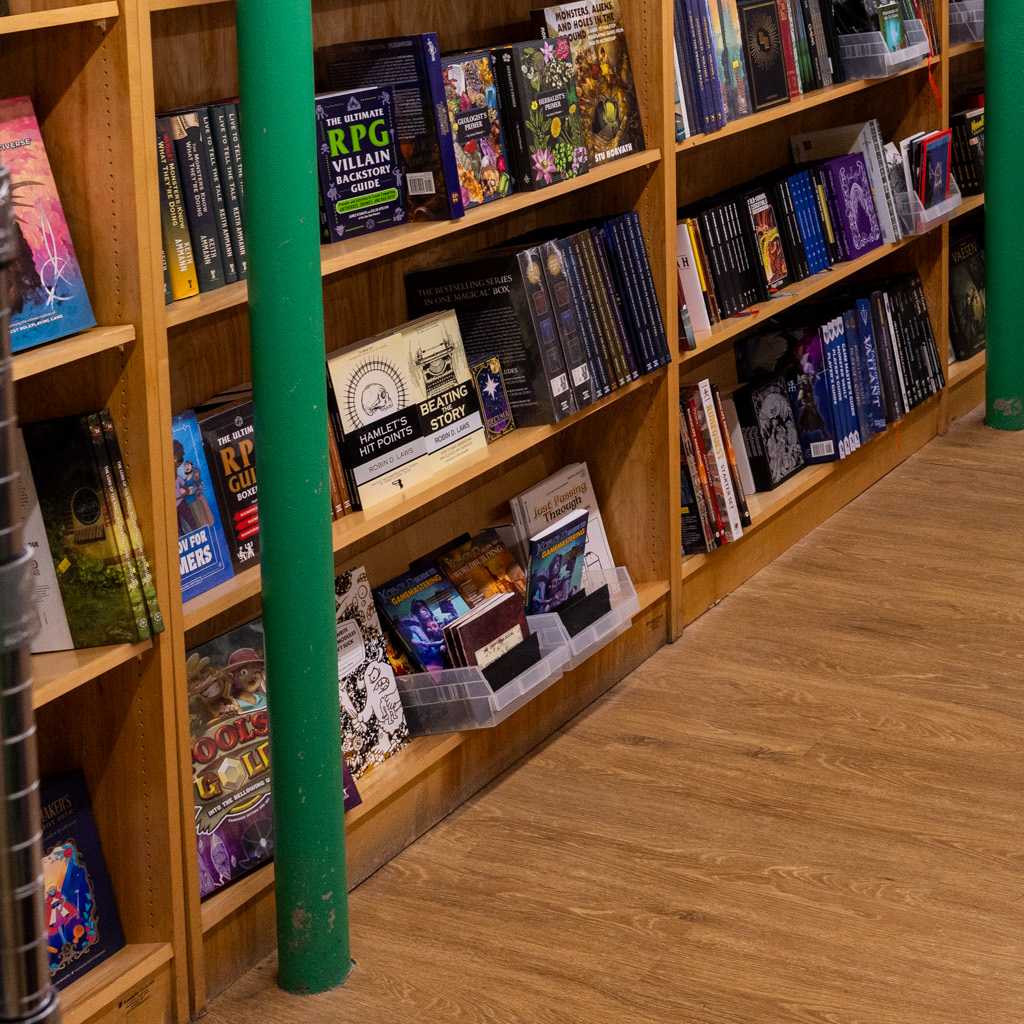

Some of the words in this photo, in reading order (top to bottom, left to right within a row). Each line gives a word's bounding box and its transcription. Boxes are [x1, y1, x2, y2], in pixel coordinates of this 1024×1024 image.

[555, 6, 589, 21] MONSTERS,
[591, 1, 613, 13] ALIENS,
[558, 22, 572, 33] AND
[573, 16, 593, 28] HOLES
[594, 15, 601, 25] IN
[602, 13, 614, 22] THE
[539, 92, 565, 105] HERBALIST'S
[545, 101, 561, 110] PRIMER
[203, 116, 211, 134] LIVE
[217, 115, 226, 132] LIVE
[326, 117, 341, 126] THE
[344, 108, 384, 122] ULTIMATE
[458, 112, 487, 125] GEOLOGIST'S
[465, 121, 482, 131] PRIMER
[206, 136, 213, 146] TO
[221, 135, 227, 144] TO
[327, 119, 389, 157] RPG
[185, 141, 194, 162] WHAT
[208, 147, 216, 166] TELL
[222, 145, 231, 164] TELL
[332, 149, 390, 172] VILLAIN
[595, 152, 605, 162] STU
[606, 143, 632, 158] HORVATH
[163, 135, 173, 162] MOAR!
[168, 163, 181, 205] MONSTERS
[176, 206, 186, 229] KNOW
[189, 164, 200, 194] THEY'RE
[226, 166, 234, 180] THE
[336, 165, 390, 184] BACKSTORY
[157, 141, 167, 163] WHAT
[162, 166, 174, 199] THEY'RE
[168, 201, 179, 227] DOING
[193, 154, 205, 190] MONSTERS
[200, 192, 209, 213] KNOW
[214, 184, 223, 202] TALE
[229, 183, 237, 200] TALE
[351, 179, 380, 192] GUIDE
[194, 194, 203, 217] DOING
[218, 208, 228, 227] KEITH
[232, 207, 242, 226] KEITH
[200, 235, 211, 265] AMMANN
[208, 238, 217, 258] KEITH
[222, 228, 233, 257] AMMANN
[235, 227, 246, 255] AMMANN
[174, 239, 187, 272] AMMANN
[183, 242, 193, 264] KEITH
[952, 241, 978, 262] VAESEN
[418, 288, 433, 297] THE
[435, 280, 485, 295] BESTSELLING
[487, 275, 512, 286] SERIES
[434, 294, 451, 304] ONE
[493, 286, 509, 295] BOX
[841, 343, 849, 362] GAME
[843, 363, 853, 397] MASTER'S
[863, 335, 880, 408] VALIANT
[420, 385, 468, 416] BEATING
[835, 382, 843, 402] GUIDE
[442, 405, 452, 414] THE
[848, 397, 856, 417] GUIDE
[430, 405, 466, 430] STORY
[488, 412, 509, 425] DECUMA
[217, 434, 231, 446] THE
[233, 426, 254, 440] ULTIM
[360, 416, 408, 444] HAMLET'S
[434, 430, 451, 444] ROBIN
[451, 429, 458, 439] D.
[457, 421, 470, 435] LAWS
[360, 441, 377, 457] HIT
[377, 426, 413, 450] POINTS
[706, 404, 725, 460] RUNEQUEST
[720, 464, 733, 497] STARTER
[369, 458, 388, 473] ROBIN
[389, 456, 396, 464] D.
[397, 448, 413, 461] LAWS
[533, 503, 552, 519] Just
[553, 482, 588, 505] Passing
[544, 496, 582, 523] Through
[191, 530, 207, 548] FOR
[542, 528, 585, 559] GAMEMASTERING
[453, 546, 503, 578] WORLDBUILDING
[392, 574, 442, 606] GAMEMASTERING
[343, 639, 354, 648] SUCK
[193, 711, 268, 764] OOL'S
[208, 803, 222, 816] INTO
[223, 797, 234, 809] THE
[233, 781, 265, 801] BELLOWING
